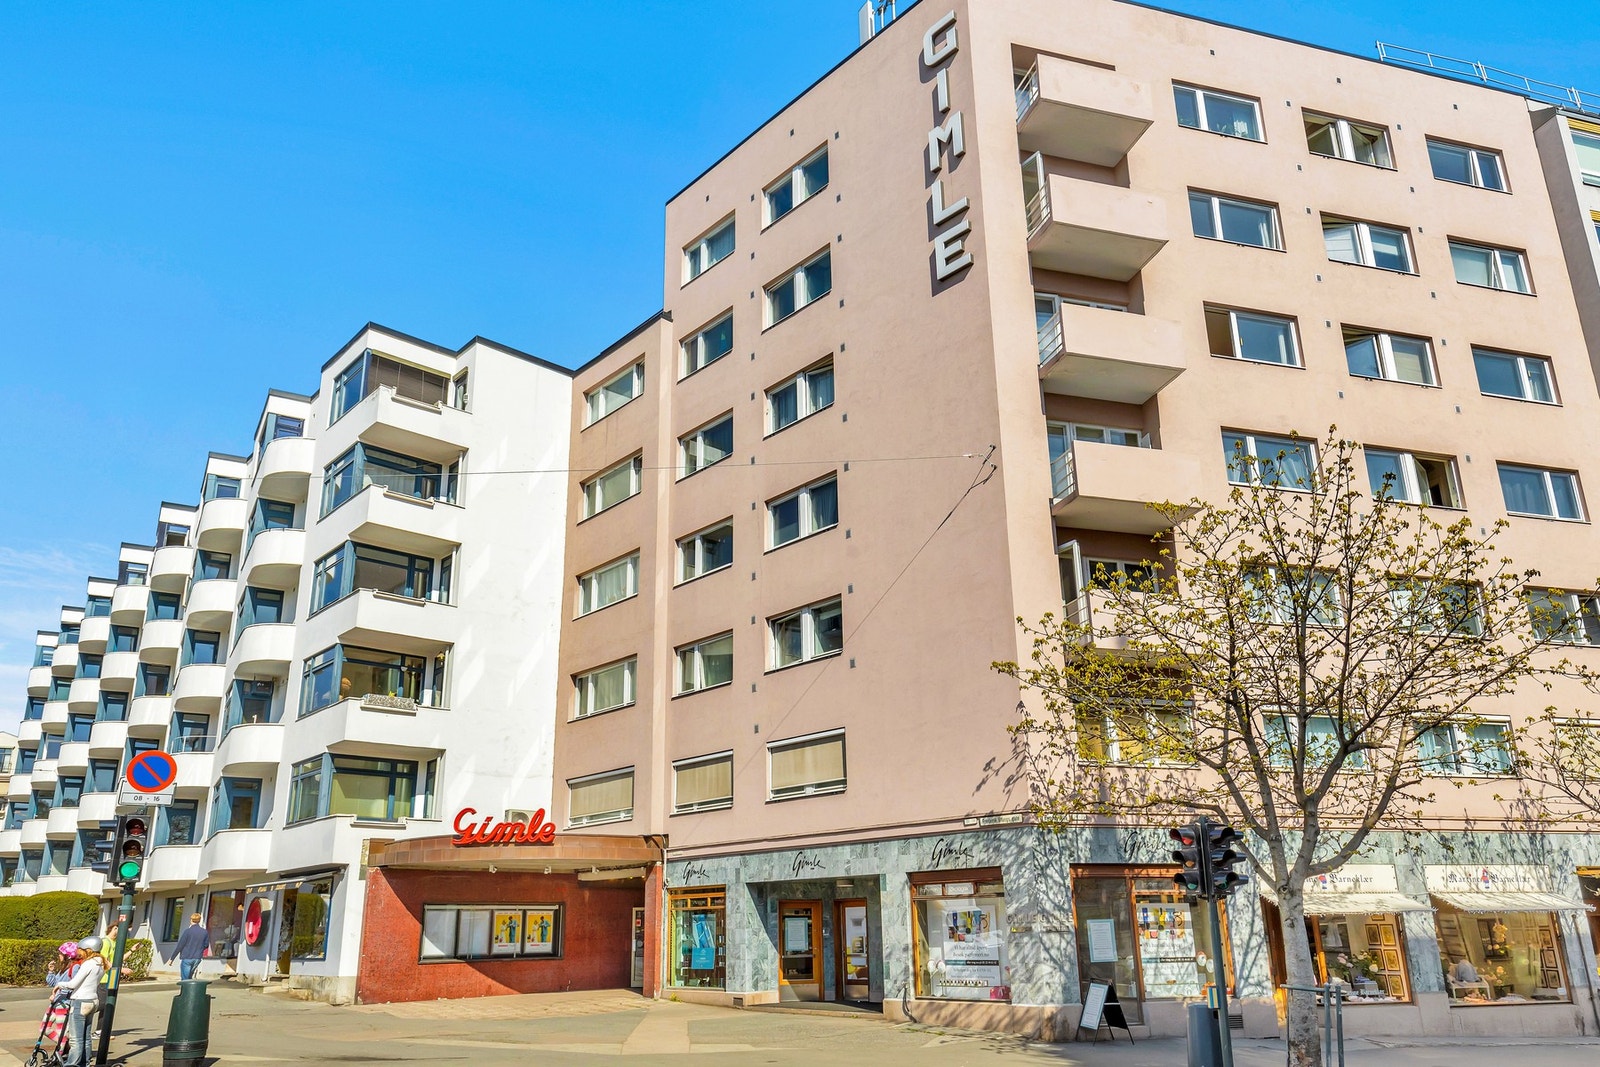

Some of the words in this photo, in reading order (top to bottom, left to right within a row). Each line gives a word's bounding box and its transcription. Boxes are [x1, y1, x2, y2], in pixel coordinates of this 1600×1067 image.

[923, 9, 974, 281] GIMLE
[452, 807, 557, 846] Gimle
[792, 851, 826, 877] Gimle
[931, 838, 974, 868] Gimle
[682, 861, 710, 885] Gimle
[1329, 873, 1374, 884] Barneklær
